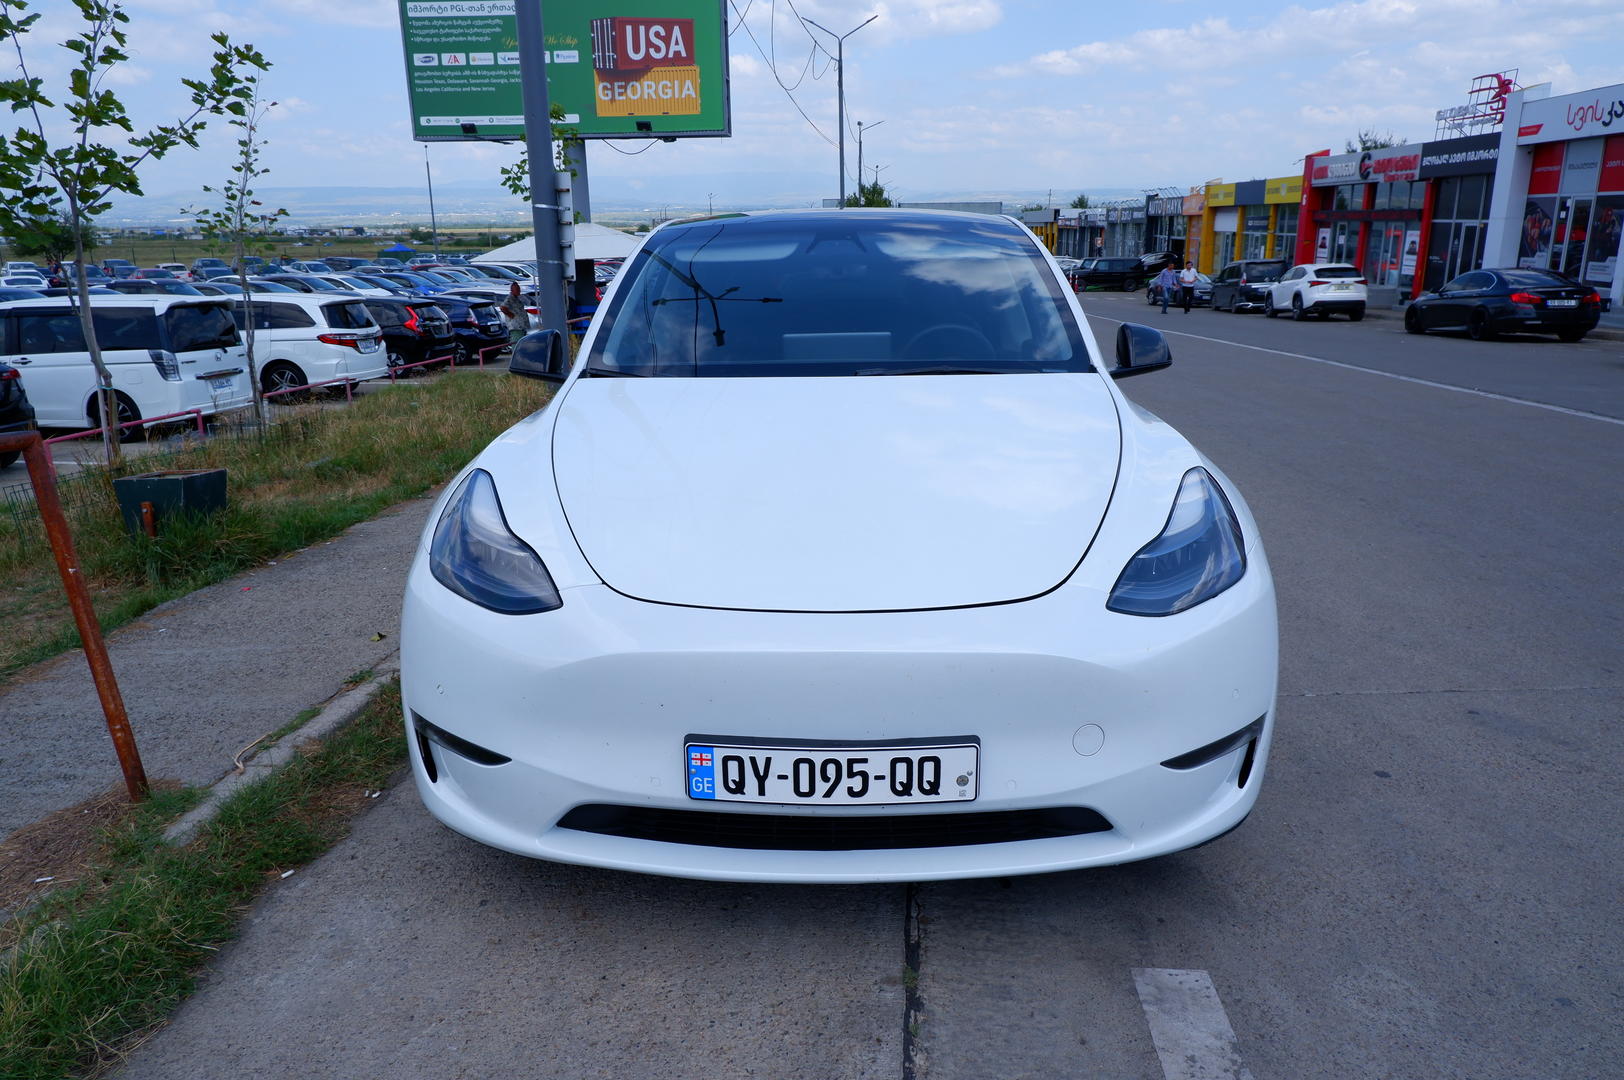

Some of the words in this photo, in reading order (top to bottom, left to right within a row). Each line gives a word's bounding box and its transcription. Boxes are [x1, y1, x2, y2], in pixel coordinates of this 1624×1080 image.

[408, 5, 448, 14] იმპორტი
[450, 4, 485, 13] PGL-თან
[625, 24, 687, 60] USA
[598, 79, 697, 101] GEORGIA
[692, 776, 713, 794] GE
[721, 754, 942, 799] QY-095-QQ
